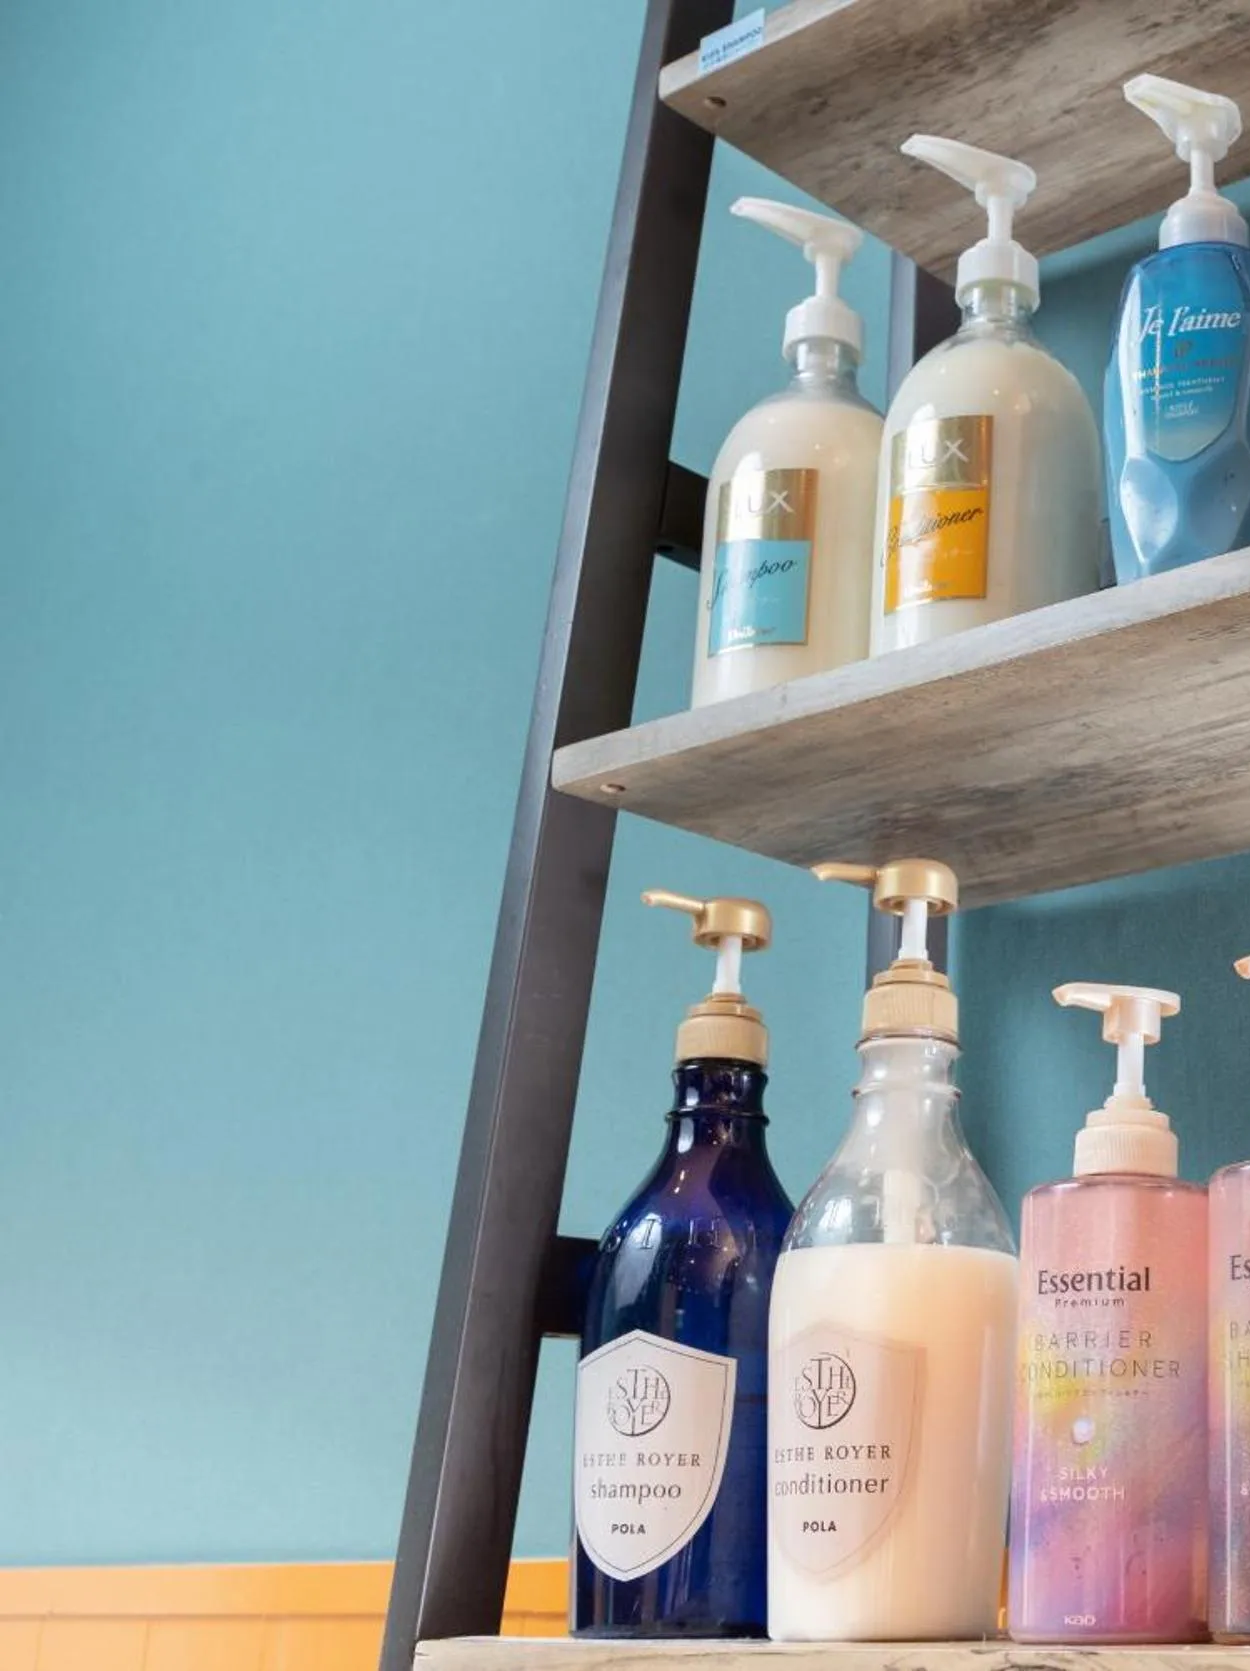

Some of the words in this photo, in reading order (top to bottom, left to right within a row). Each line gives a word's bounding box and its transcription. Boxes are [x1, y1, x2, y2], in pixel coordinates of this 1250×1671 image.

[1139, 303, 1165, 344] Je
[1168, 306, 1241, 336] l'aime
[735, 490, 796, 518] UX
[1038, 1265, 1150, 1295] Essential
[1054, 1298, 1125, 1309] Premium
[1034, 1330, 1152, 1351] BARRIER
[1021, 1358, 1180, 1382] ONDITIONER
[636, 1453, 701, 1467] ROYER
[824, 1445, 891, 1460] ROYER
[1058, 1465, 1109, 1481] SILKY
[590, 1477, 682, 1504] shampoo
[775, 1473, 889, 1496] conditioner
[611, 1524, 646, 1535] POLA
[803, 1521, 837, 1532] POLA
